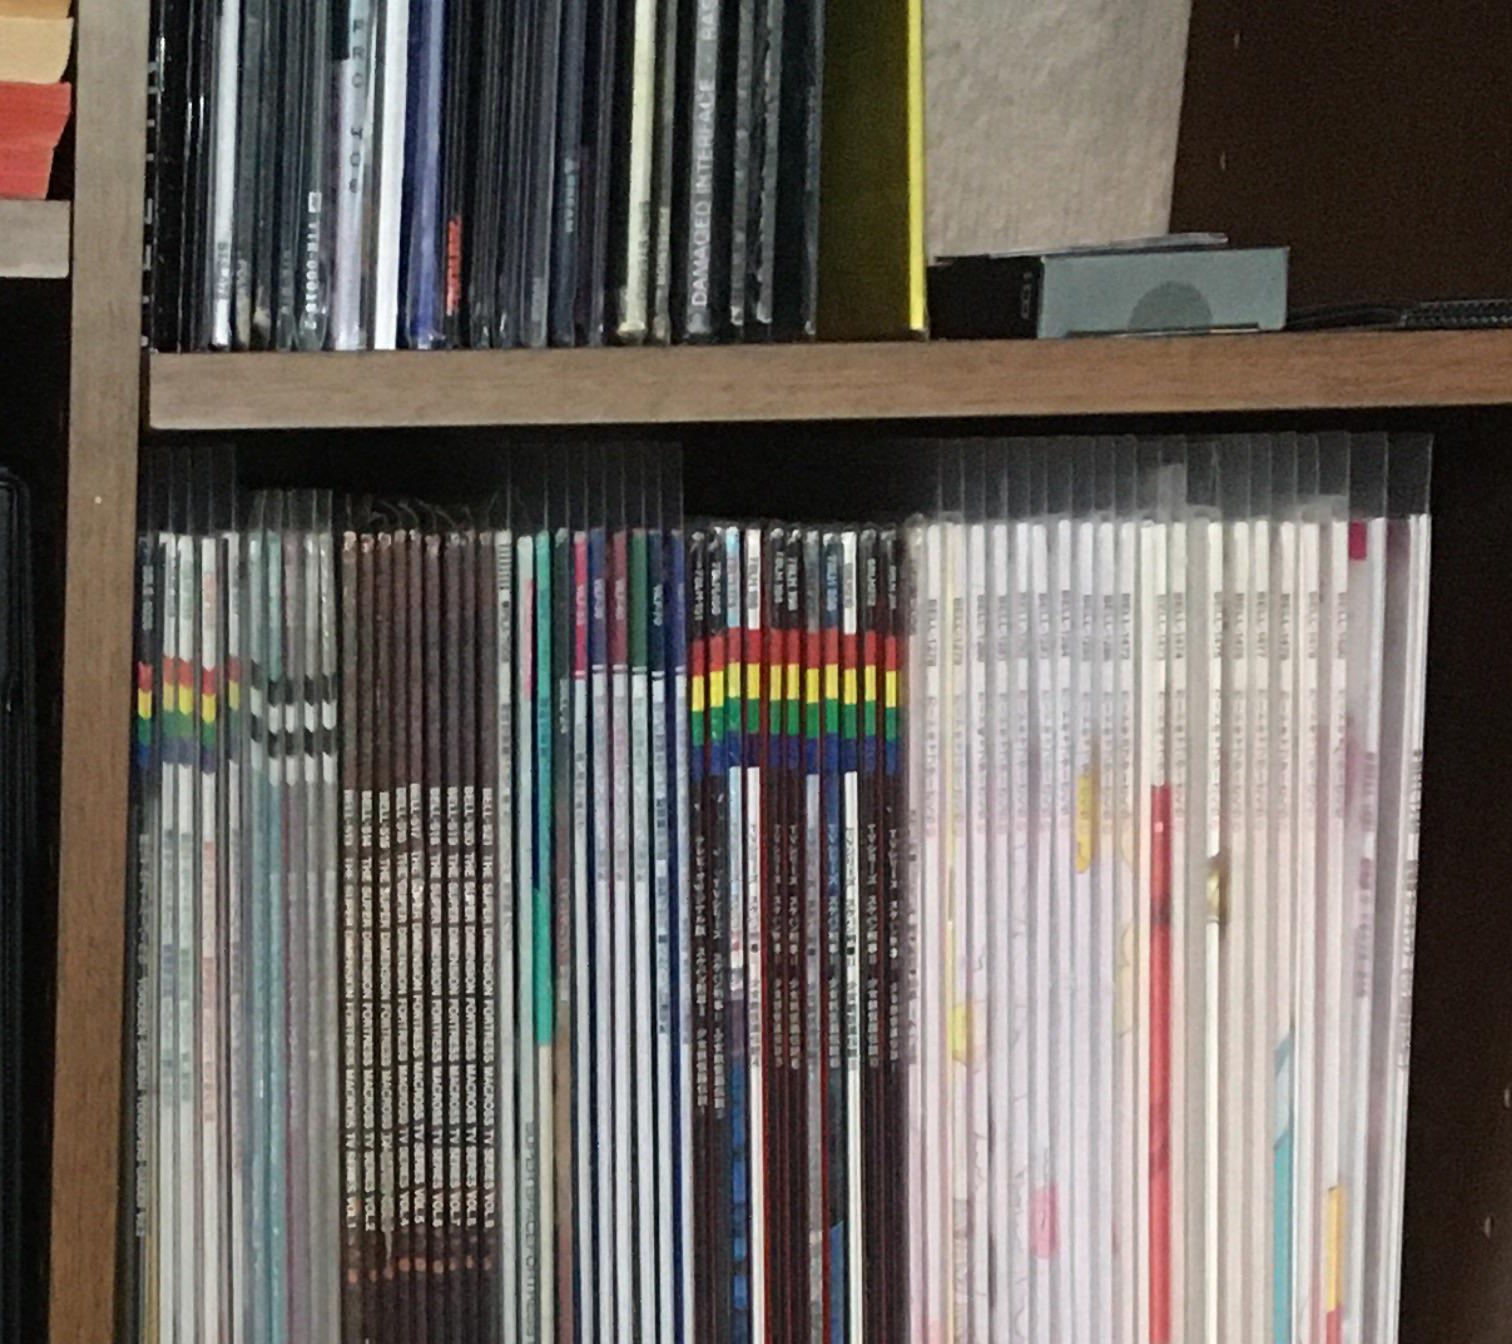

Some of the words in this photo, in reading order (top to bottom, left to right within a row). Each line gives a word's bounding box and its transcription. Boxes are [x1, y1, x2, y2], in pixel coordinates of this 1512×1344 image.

[362, 858, 372, 881] THE
[411, 851, 423, 874] THE
[465, 854, 475, 877] THE
[483, 856, 493, 878] THE
[362, 885, 372, 927] SUPER
[411, 879, 423, 919] SUPER
[465, 881, 475, 921] SUPER
[483, 883, 493, 923] SUPER
[362, 931, 372, 998] DIMENSION
[411, 923, 423, 991] DIMENSION
[465, 926, 475, 993] DIMENSION
[483, 928, 493, 995] DIMENSION
[363, 1003, 374, 1066] FORTRESS
[414, 995, 424, 1057] FORTRESS
[466, 997, 476, 1060] FORTRESS
[484, 1000, 494, 1063] FORTRESS
[363, 1070, 374, 1128] MACROSS
[414, 1062, 424, 1121] MACROSS
[466, 1064, 476, 1123] MACROSS
[484, 1066, 494, 1125] MACROSS
[363, 1132, 374, 1148] TV
[414, 1124, 424, 1140] TV
[466, 1127, 476, 1143] TV
[484, 1129, 494, 1144] TV
[363, 1152, 374, 1192] SERIES
[414, 1142, 424, 1184] SERIES
[466, 1146, 476, 1187] SERIES
[484, 1148, 494, 1189] SERIES
